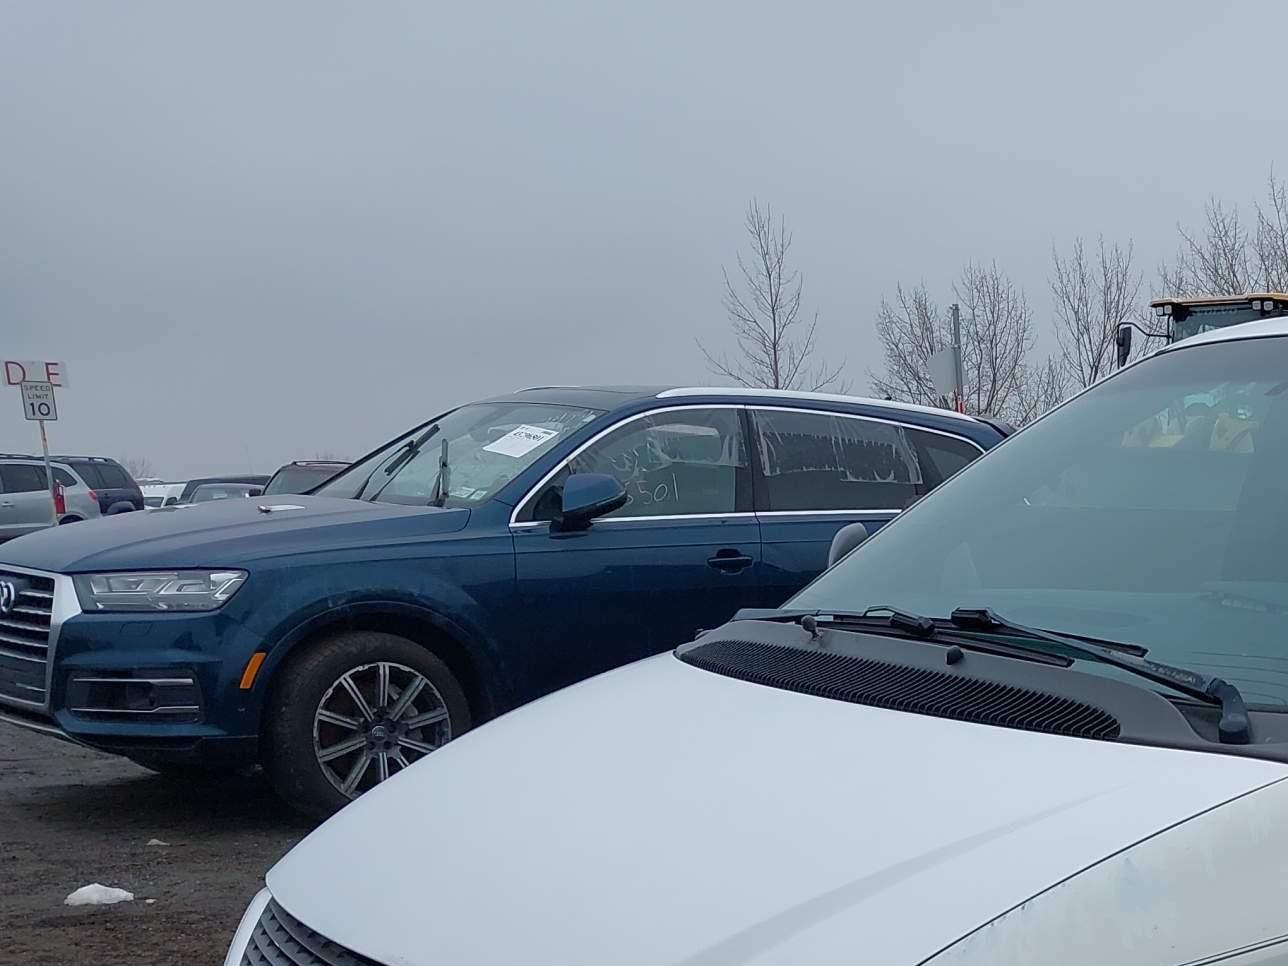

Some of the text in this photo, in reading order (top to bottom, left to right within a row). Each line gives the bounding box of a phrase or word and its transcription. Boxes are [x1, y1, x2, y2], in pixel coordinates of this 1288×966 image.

[5, 361, 62, 387] D E
[23, 384, 51, 392] SPEED
[30, 402, 51, 417] 10
